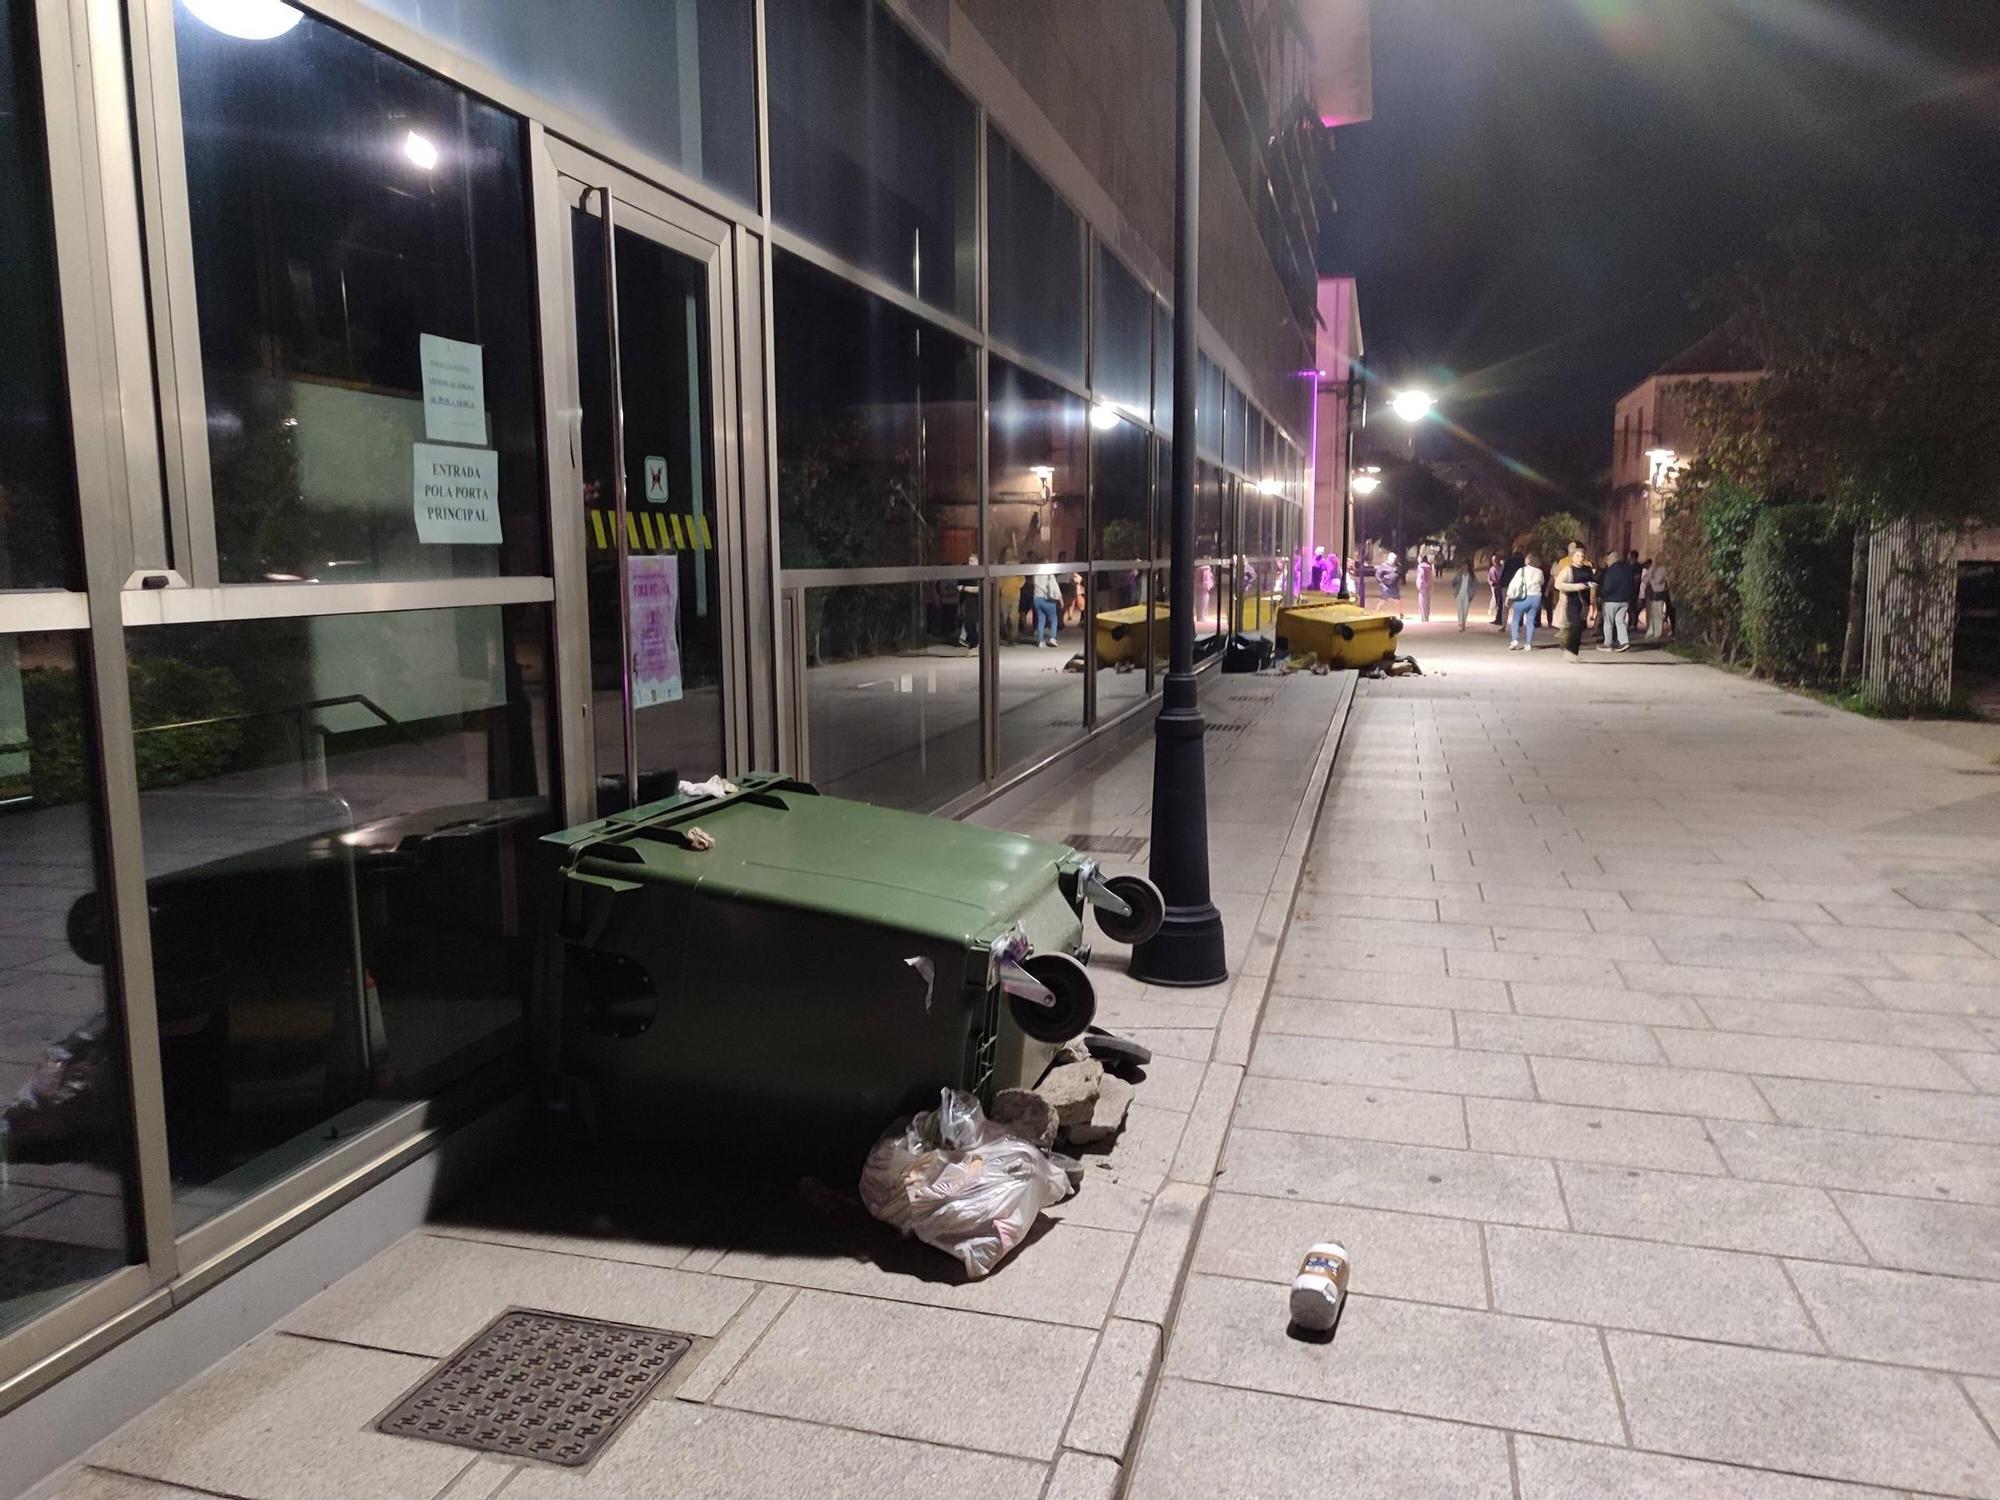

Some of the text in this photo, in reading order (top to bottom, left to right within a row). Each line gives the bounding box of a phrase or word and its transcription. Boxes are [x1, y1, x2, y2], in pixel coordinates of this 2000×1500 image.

[432, 463, 481, 479] ENTRADA
[425, 484, 489, 500] POLA PORTA
[427, 506, 489, 522] PRINCIPAL
